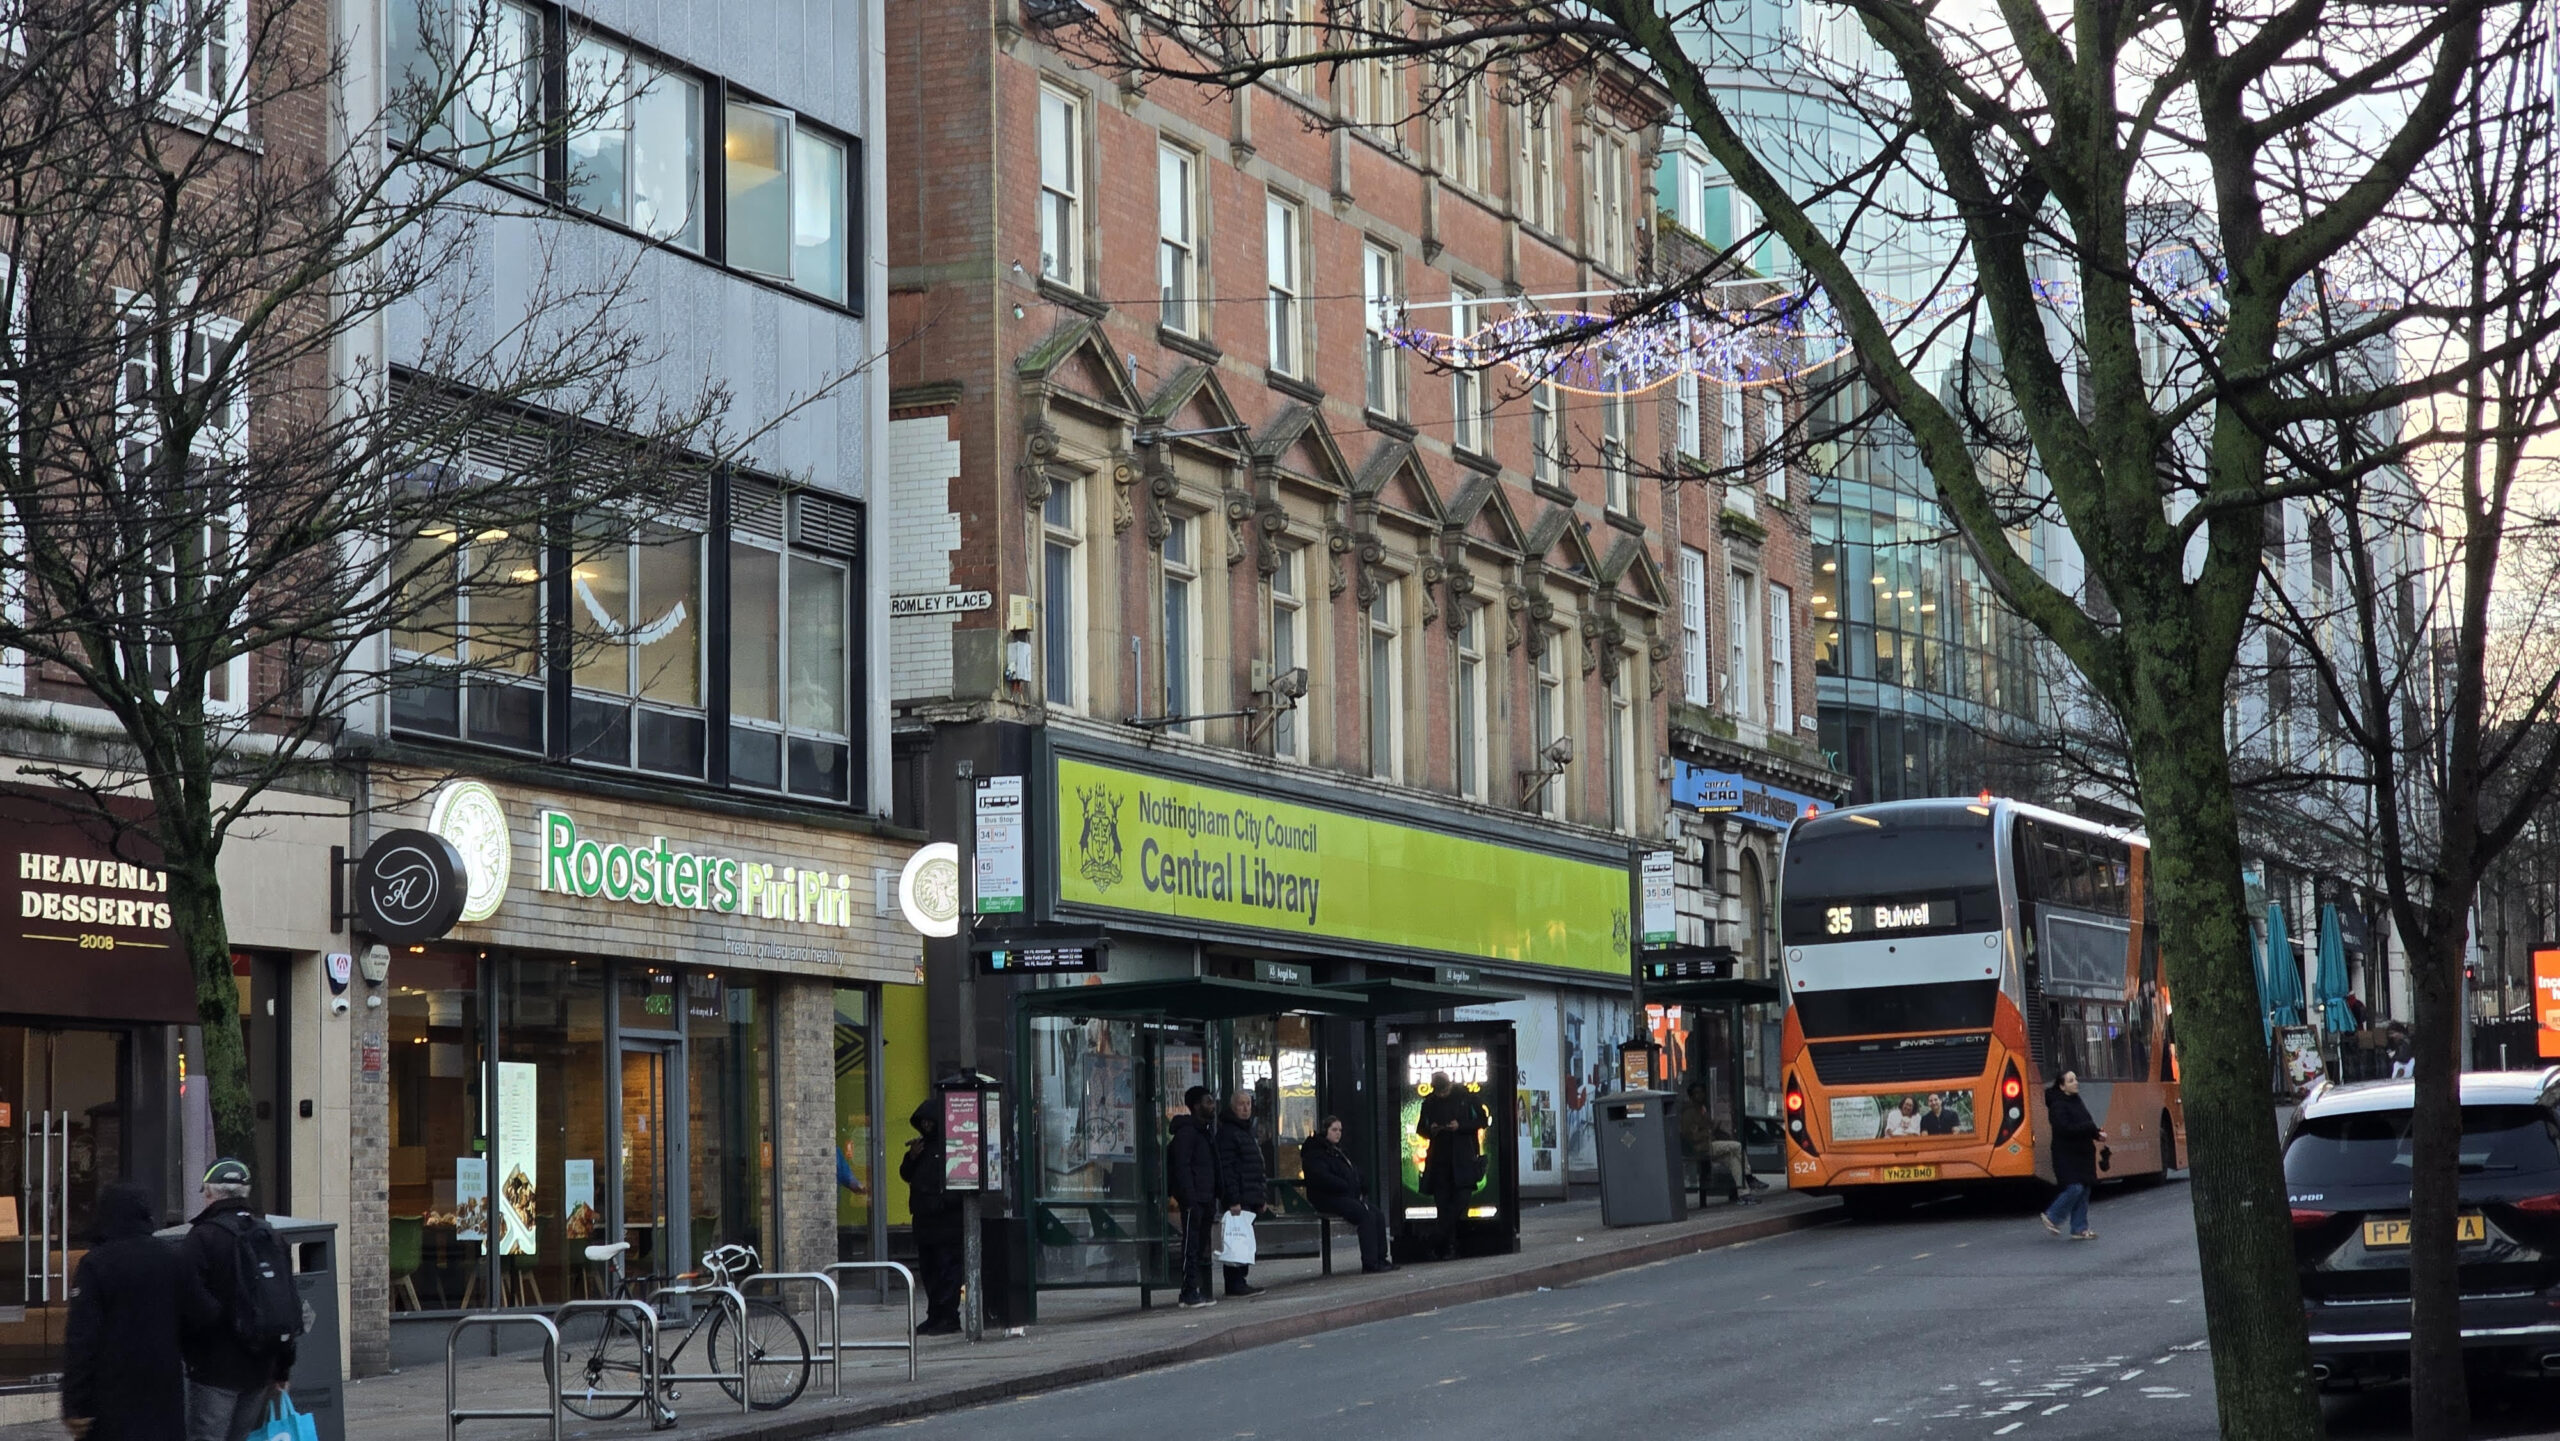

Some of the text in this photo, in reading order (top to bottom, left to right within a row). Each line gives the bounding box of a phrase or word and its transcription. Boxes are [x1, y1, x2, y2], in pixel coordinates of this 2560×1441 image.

[890, 594, 988, 613] ROMLEY PLACE
[1698, 790, 1738, 801] NERO
[999, 816, 1014, 824] Stop
[1139, 790, 1317, 854] Nottingham City Council
[980, 831, 991, 840] 34
[541, 810, 738, 914] Roosters
[980, 862, 991, 872] 45
[1140, 837, 1320, 926] Central Library
[742, 861, 851, 928] Piri Piri
[1646, 887, 1672, 898] 35 36
[21, 890, 172, 930] DESSERTS
[1827, 902, 1930, 935] 35 Bulwell
[79, 933, 115, 951] 2008
[725, 936, 845, 969] Fresh, grilled and healthy
[1965, 1035, 1986, 1043] CITY
[1409, 1052, 1487, 1068] ULTIMATE
[1409, 1066, 1488, 1085] FETIVE
[1794, 1161, 1817, 1174] 524
[1887, 1168, 1911, 1179] YN22
[2373, 1221, 2411, 1243] FP7
